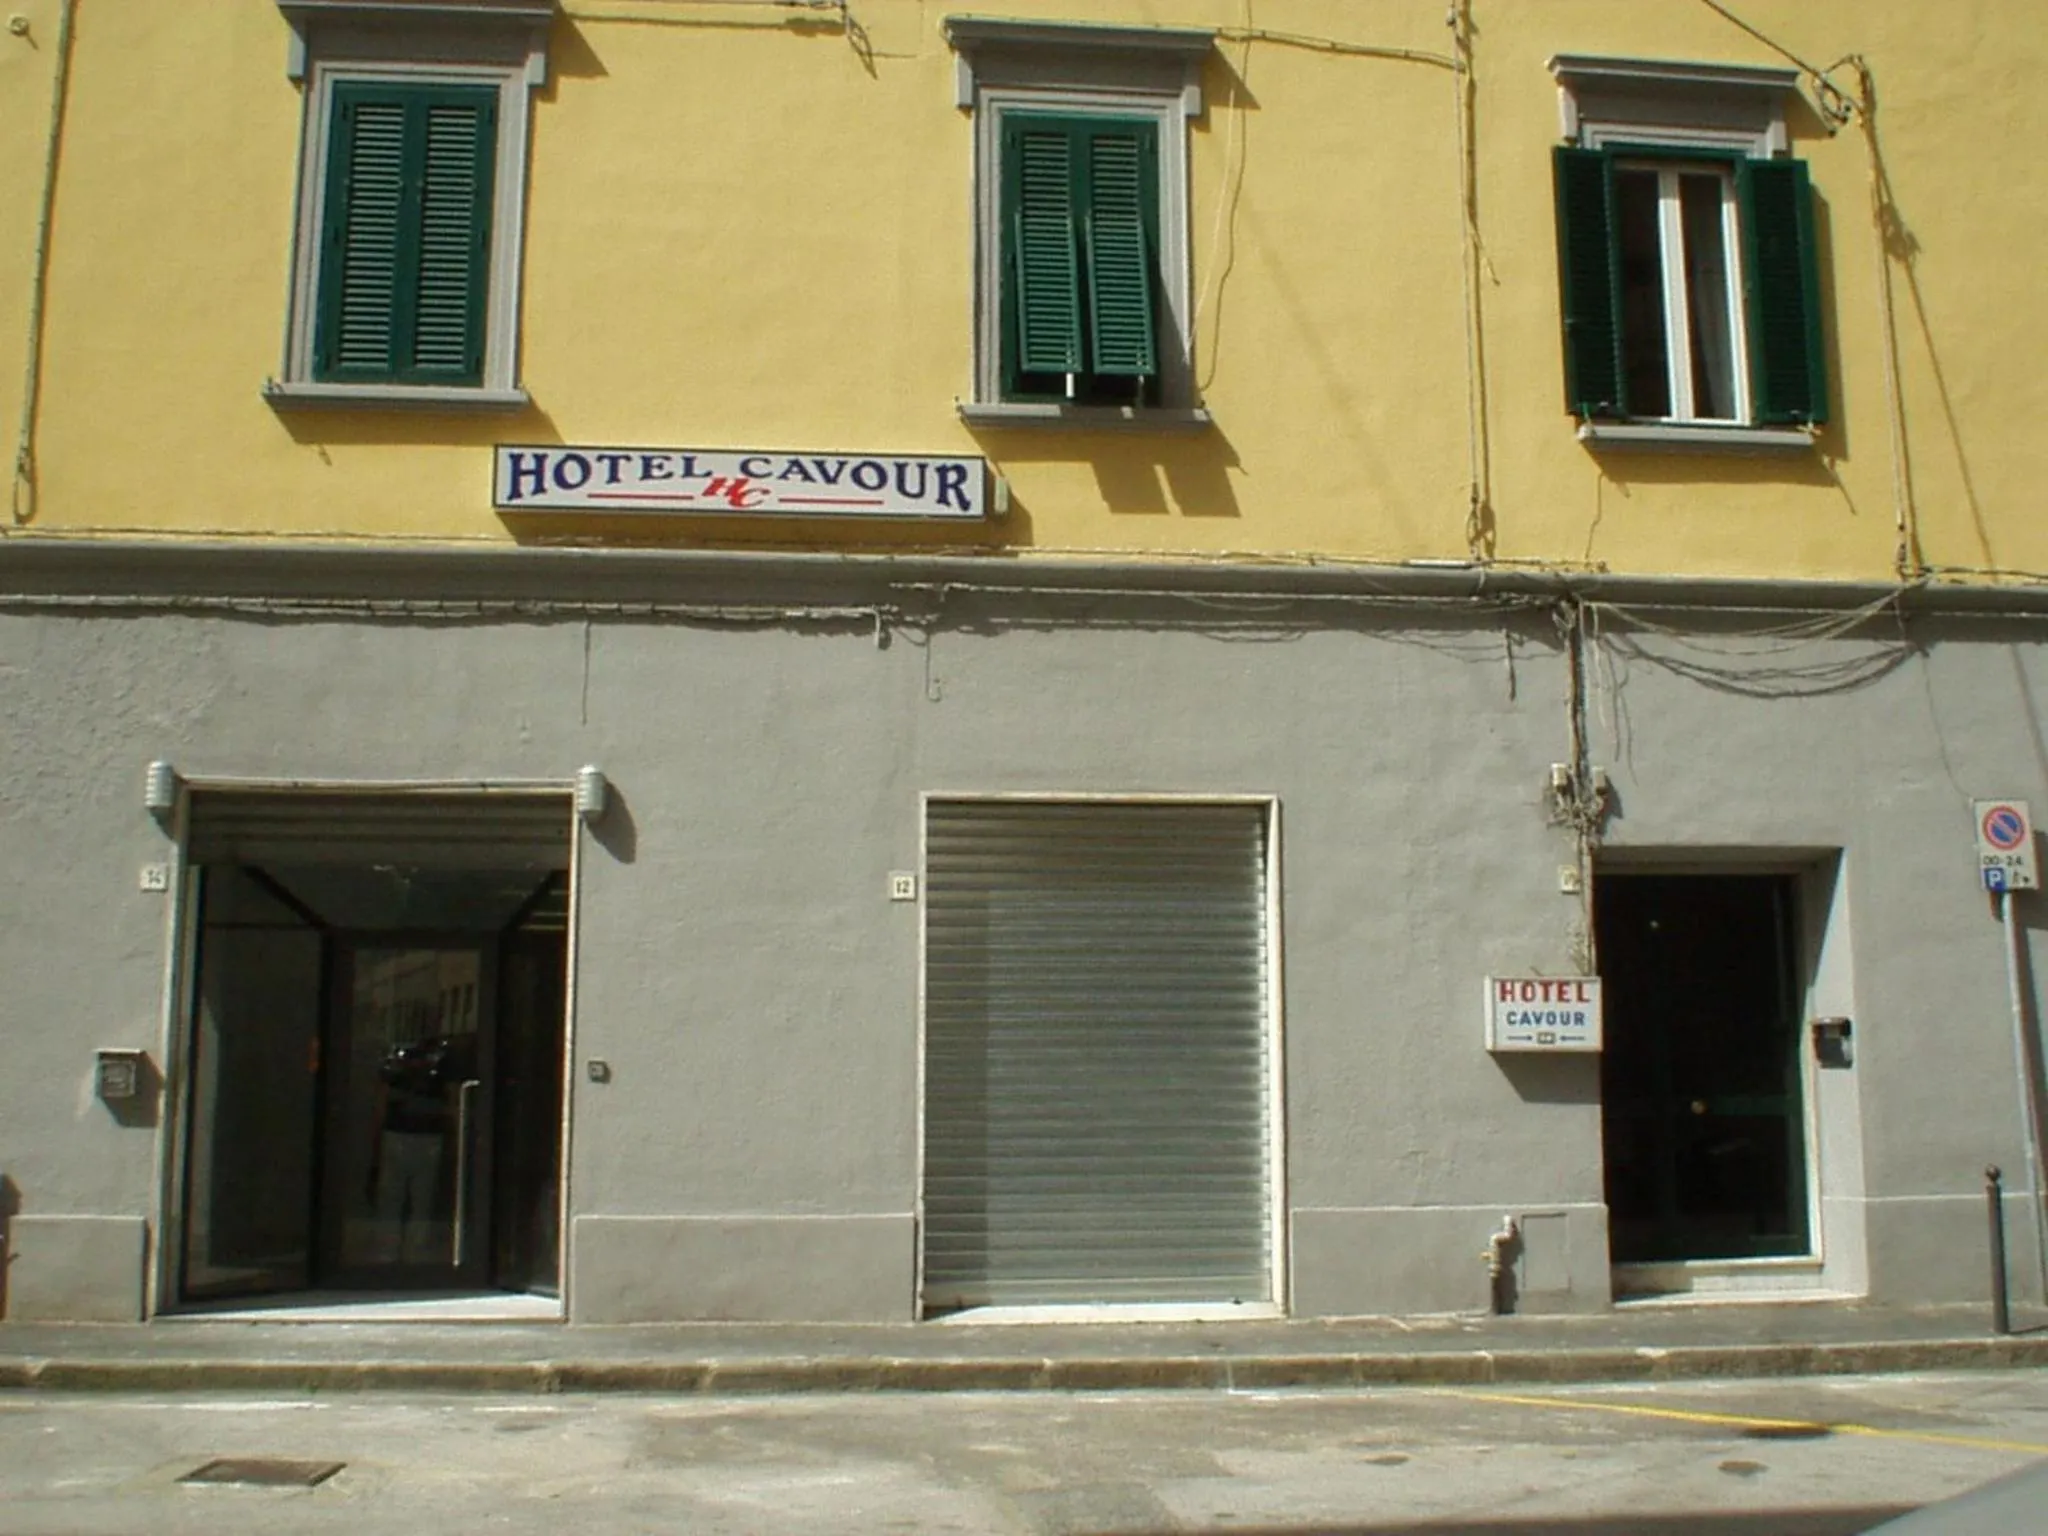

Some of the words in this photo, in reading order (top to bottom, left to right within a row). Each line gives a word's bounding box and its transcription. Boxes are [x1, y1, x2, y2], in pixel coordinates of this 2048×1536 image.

[507, 453, 713, 501] HOTEL
[739, 457, 971, 511] CAVOUR
[1988, 869, 2001, 887] P
[896, 880, 910, 895] 12
[1499, 980, 1591, 1002] HOTEL
[1506, 1011, 1585, 1025] CAVOUR
